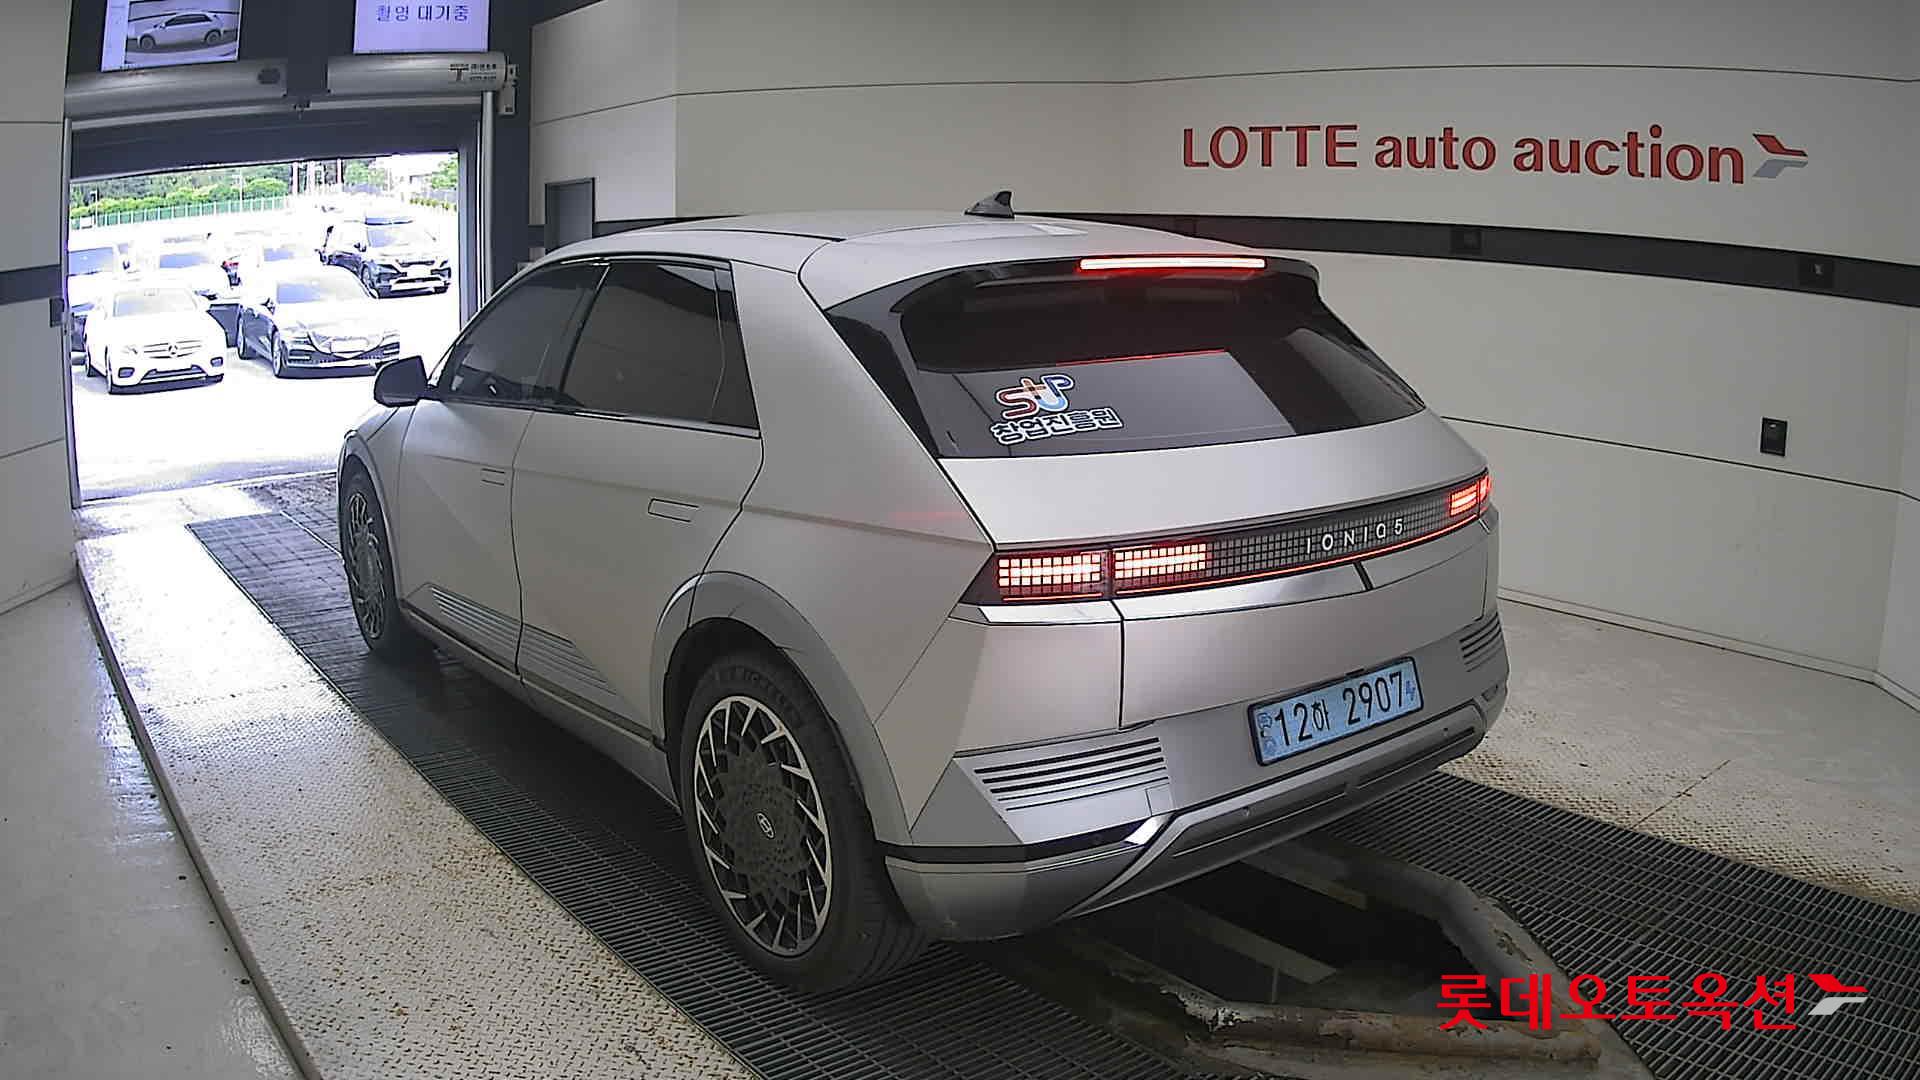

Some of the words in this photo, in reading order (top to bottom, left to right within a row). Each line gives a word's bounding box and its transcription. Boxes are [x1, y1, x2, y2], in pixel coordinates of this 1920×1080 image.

[417, 5, 468, 21] 대기중
[1183, 124, 1358, 168] LOTTE
[1374, 127, 1496, 170] auto
[1513, 124, 1745, 184] auction
[991, 408, 1122, 444] 창업진흥원
[1274, 699, 1330, 746] 12하
[1342, 671, 1402, 726] 2907
